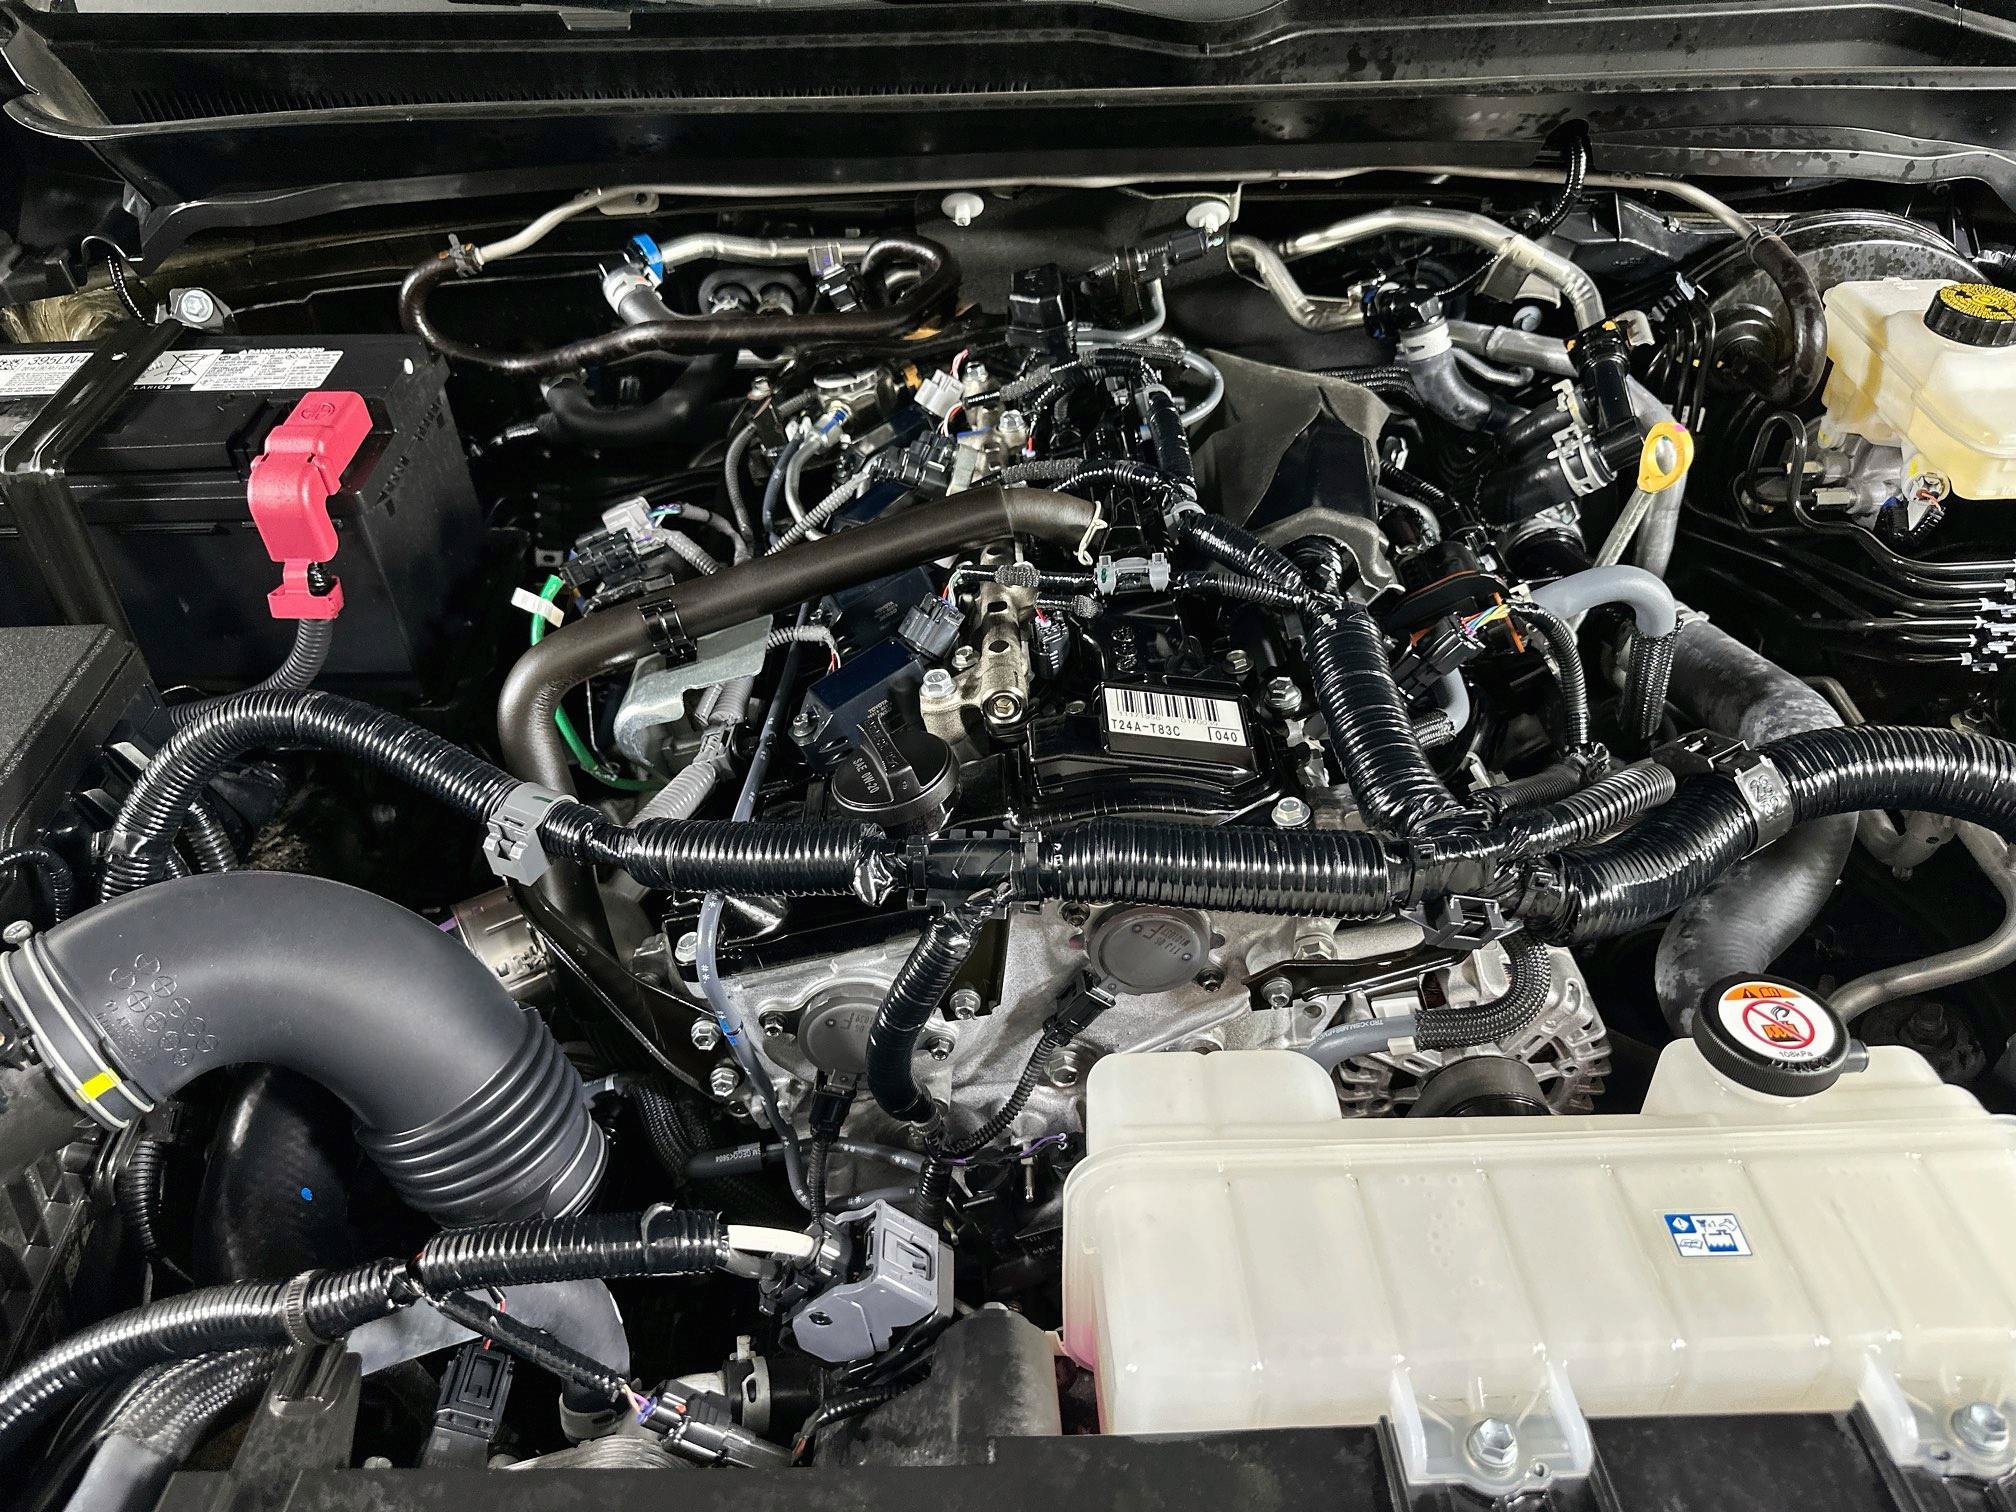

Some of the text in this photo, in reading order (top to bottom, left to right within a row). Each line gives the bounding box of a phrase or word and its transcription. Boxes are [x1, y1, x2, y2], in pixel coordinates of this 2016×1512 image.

[1111, 718, 1181, 738] T24A-T83C
[1215, 730, 1238, 743] 040
[852, 757, 868, 773] SAE
